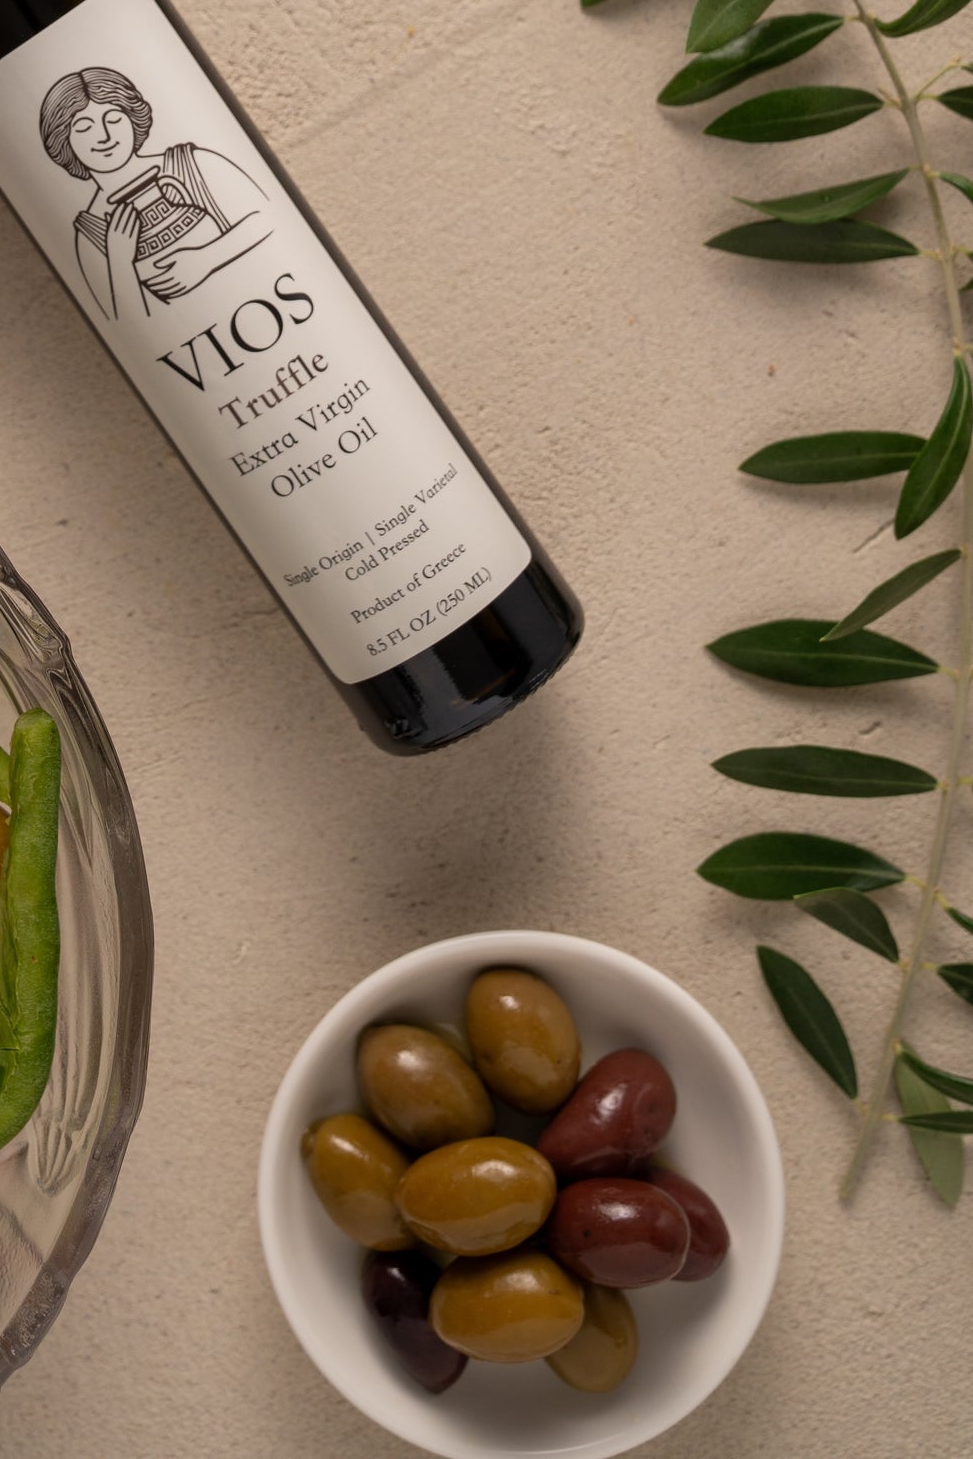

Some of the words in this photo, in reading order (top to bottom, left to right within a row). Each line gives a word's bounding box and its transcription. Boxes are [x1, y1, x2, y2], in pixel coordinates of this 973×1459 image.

[156, 273, 314, 391] VIOS
[219, 354, 328, 428] Truffle
[231, 432, 298, 476] Extra
[295, 380, 370, 431] Virgin
[271, 454, 336, 497] Olive
[338, 417, 377, 453] Oil
[283, 566, 319, 586] Single
[319, 542, 364, 570] Origin
[375, 505, 416, 536] Single
[414, 463, 457, 503] Varietal
[345, 555, 379, 580] Cold
[378, 519, 429, 561] Pressed
[350, 589, 405, 624] Product
[407, 573, 422, 591] of
[422, 544, 465, 579] Greece
[367, 638, 388, 656] 8.5
[386, 628, 410, 645] FL
[410, 610, 436, 631] OZ
[437, 589, 465, 616] (250
[464, 567, 491, 594] ML)
